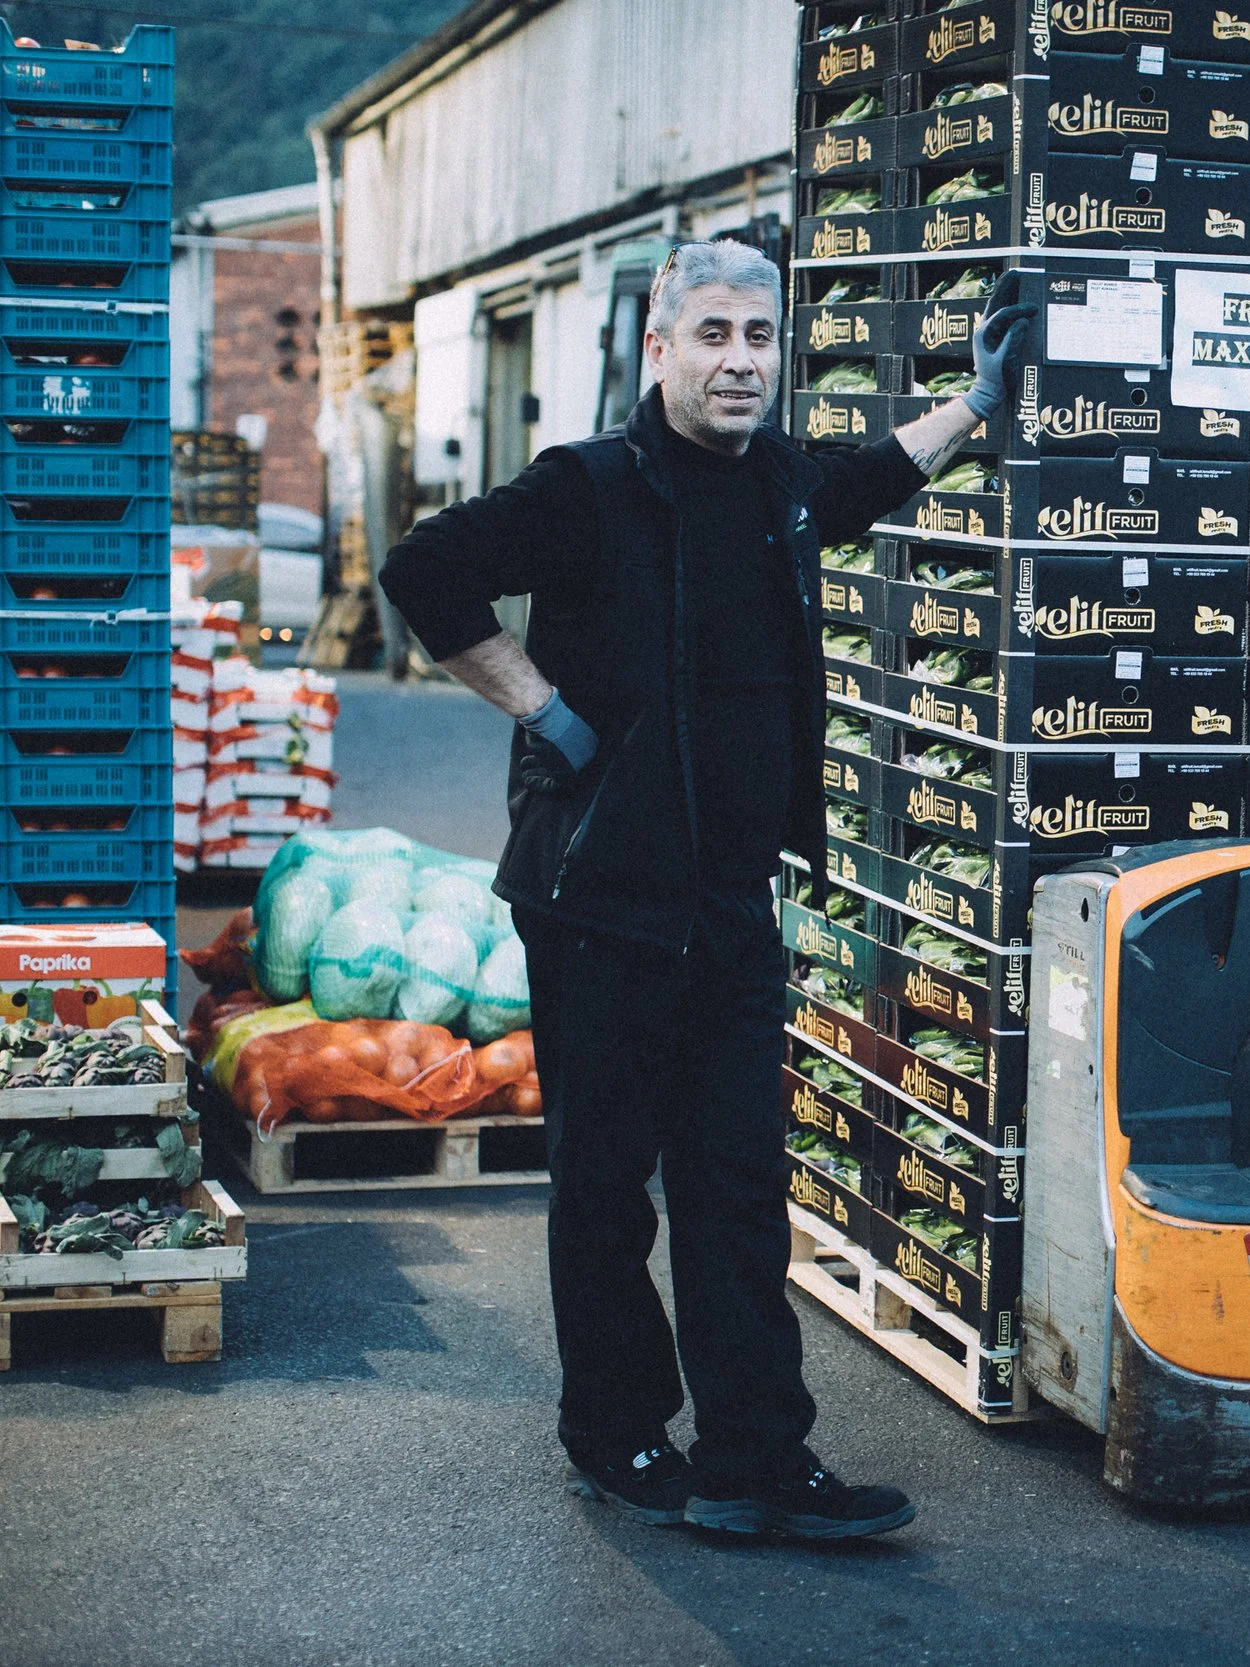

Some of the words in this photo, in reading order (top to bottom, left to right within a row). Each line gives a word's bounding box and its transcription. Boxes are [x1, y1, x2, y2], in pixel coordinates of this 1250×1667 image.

[1125, 15, 1167, 28] FRUIT
[1217, 24, 1247, 34] FRESH
[955, 26, 973, 44] FRUIT
[1122, 114, 1164, 128] FRUIT
[1213, 123, 1243, 133] FRESH
[952, 123, 970, 142] FRUIT
[1033, 176, 1042, 204] FRUIT
[1118, 213, 1161, 228] FRUIT
[1210, 221, 1240, 232] FRESH
[951, 220, 968, 238] FRUIT
[949, 317, 967, 337] FRUIT
[1027, 368, 1036, 396] FRUIT
[1114, 414, 1155, 429] FRUIT
[1206, 421, 1234, 431] FRESH
[944, 514, 961, 530] FRUIT
[1111, 515, 1154, 530] FRUIT
[1203, 521, 1232, 531] FRESH
[1022, 560, 1031, 590] FRUIT
[940, 610, 957, 630] FRUIT
[1107, 614, 1150, 628] FRUIT
[1199, 619, 1228, 629] FRESH
[937, 703, 955, 724] FRUIT
[1104, 714, 1148, 728] FRUIT
[1197, 718, 1225, 728] FRESH
[937, 798, 954, 821] FRUIT
[1102, 811, 1145, 826] FRUIT
[1193, 814, 1222, 824] FRESH
[934, 894, 952, 915] FRUIT
[1012, 940, 1021, 970] FRT
[19, 954, 91, 974] Paprika
[1007, 1128, 1015, 1155] RUIT
[925, 1174, 943, 1197] FRUIT
[1001, 1314, 1009, 1342] FRUIT
